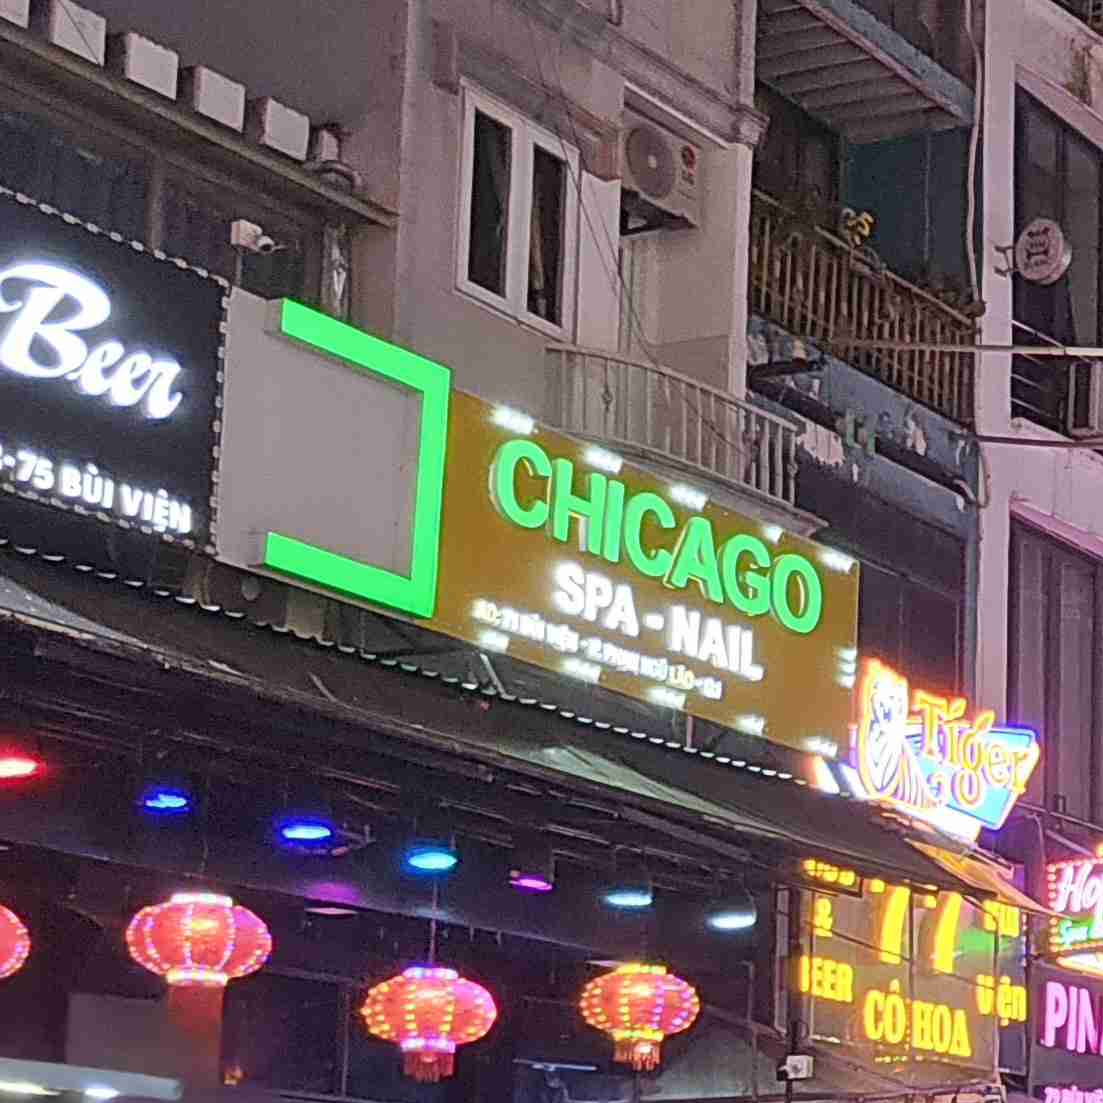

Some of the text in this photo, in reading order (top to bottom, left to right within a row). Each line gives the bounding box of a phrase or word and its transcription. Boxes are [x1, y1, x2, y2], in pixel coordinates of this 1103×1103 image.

[0, 263, 184, 420] Beer
[61, 463, 114, 509] BÙI
[120, 485, 192, 534] VIỆN
[490, 439, 823, 634] CHICAGO
[554, 562, 640, 637] SPA
[668, 605, 764, 681] NAIL
[864, 979, 972, 1057] CÔ HOA
